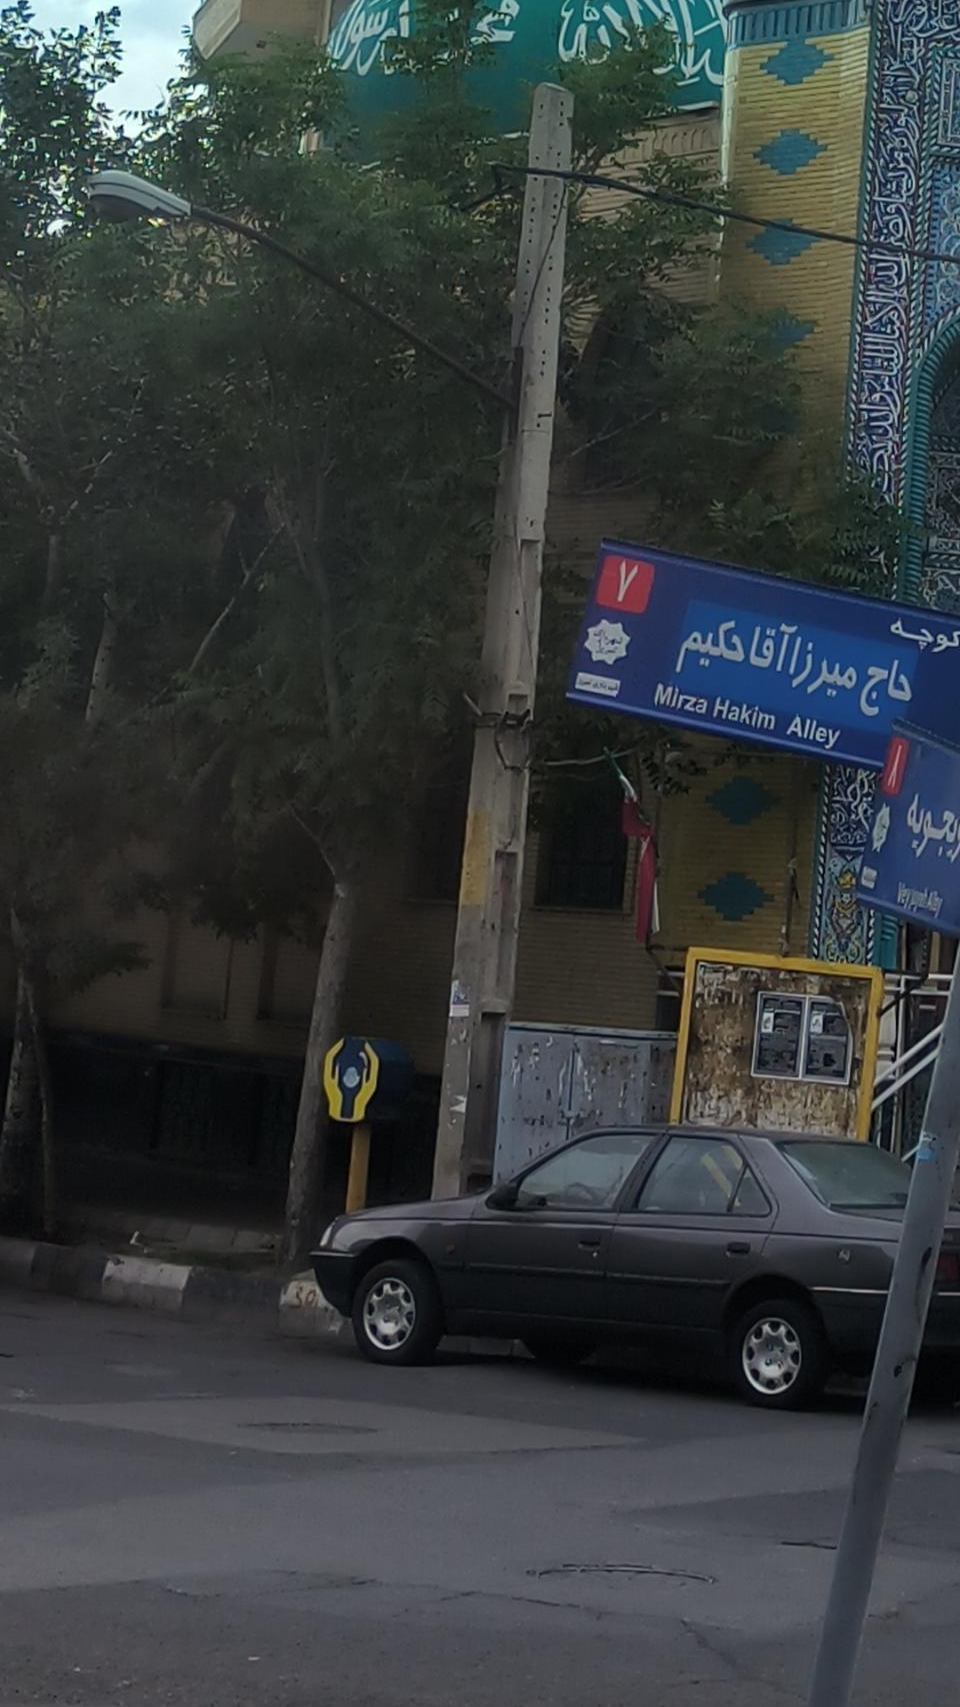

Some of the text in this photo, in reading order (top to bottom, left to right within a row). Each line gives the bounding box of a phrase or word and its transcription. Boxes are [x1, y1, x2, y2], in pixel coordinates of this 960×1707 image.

[674, 619, 746, 674] حکیم
[653, 682, 708, 715] Mirza
[712, 695, 777, 731] Hakim
[785, 713, 842, 750] Alley
[859, 658, 913, 716] حاج
